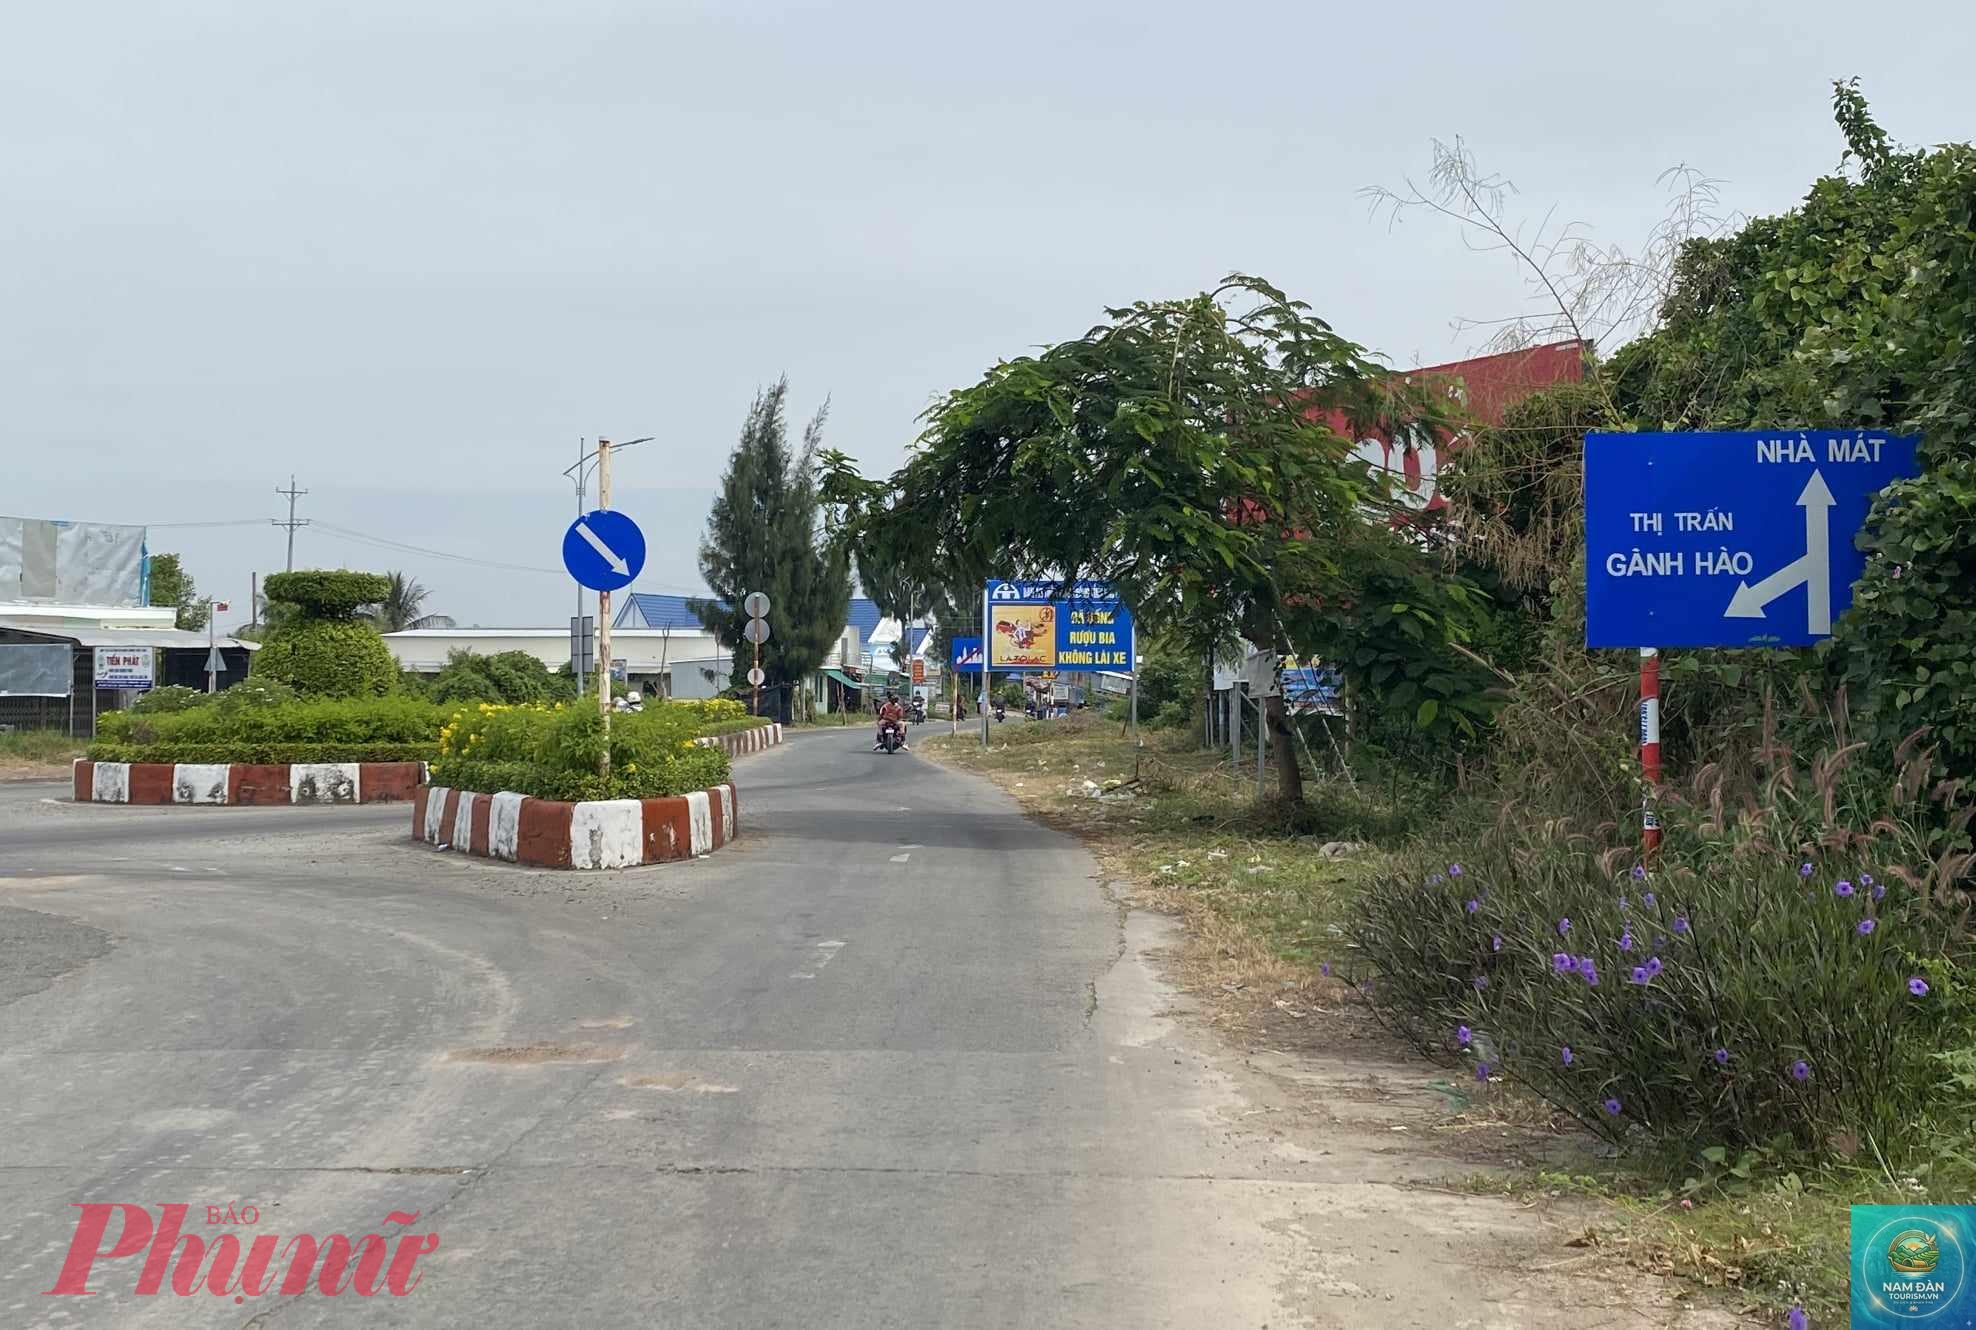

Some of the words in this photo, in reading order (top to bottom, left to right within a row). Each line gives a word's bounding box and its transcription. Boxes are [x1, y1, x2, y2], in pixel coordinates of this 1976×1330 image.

[1757, 432, 1816, 463] NHÀ
[1828, 432, 1886, 463] MÁT
[1629, 512, 1662, 536] THỊ
[1673, 506, 1733, 531] TRẤN
[1695, 546, 1753, 576] HÀO
[1069, 630, 1096, 647] RƯỢU
[1098, 631, 1115, 644] BIA
[1059, 649, 1093, 664] KHÔNG
[1095, 650, 1111, 664] LÁI
[1113, 651, 1127, 664] XE
